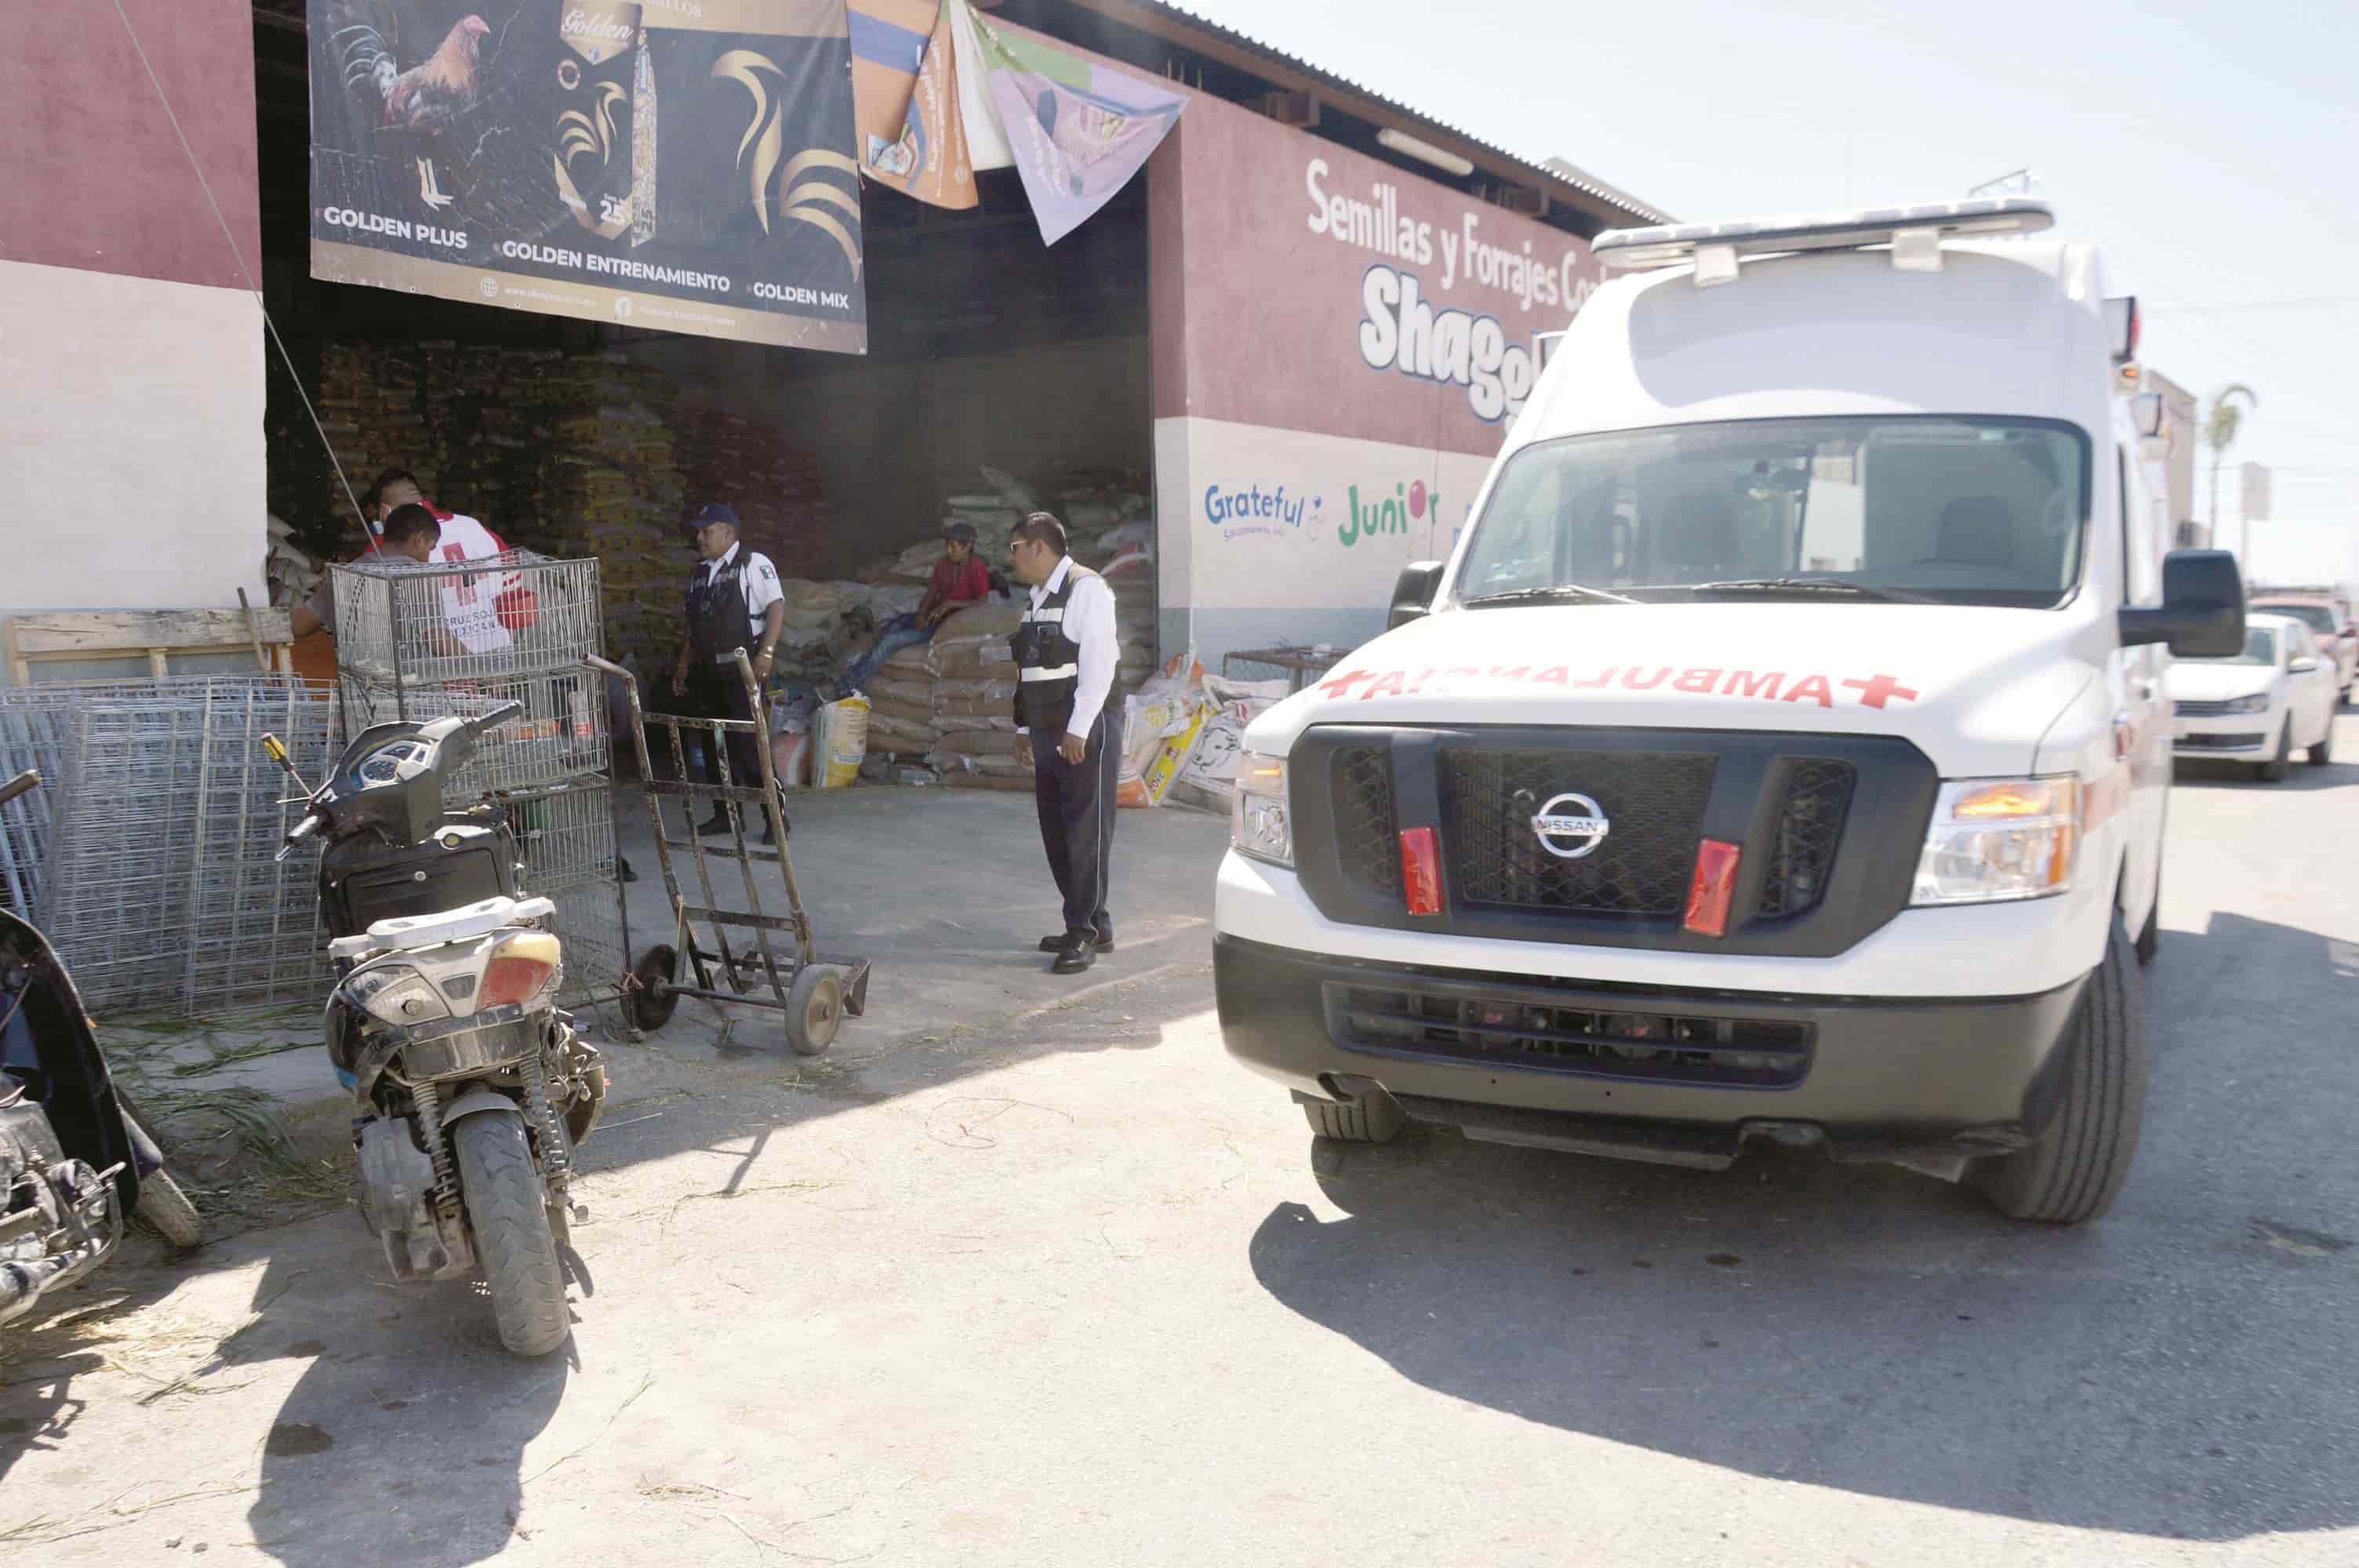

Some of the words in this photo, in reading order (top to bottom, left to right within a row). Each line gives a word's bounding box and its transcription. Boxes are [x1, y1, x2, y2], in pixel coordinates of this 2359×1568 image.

[324, 206, 413, 240] GOLDEN
[416, 224, 468, 249] PLUS
[1306, 158, 1433, 267] Semillas
[1439, 227, 1459, 291] y
[1463, 212, 1559, 313] Forrajes
[502, 240, 582, 269] GOLDEN
[586, 255, 731, 292] ENTRENAMIENTO
[753, 281, 818, 305] GOLDEN
[820, 290, 850, 310] MIX
[1205, 484, 1305, 528] Grateful
[1338, 479, 1440, 547] Junior
[1537, 818, 1600, 833] NISSAN
